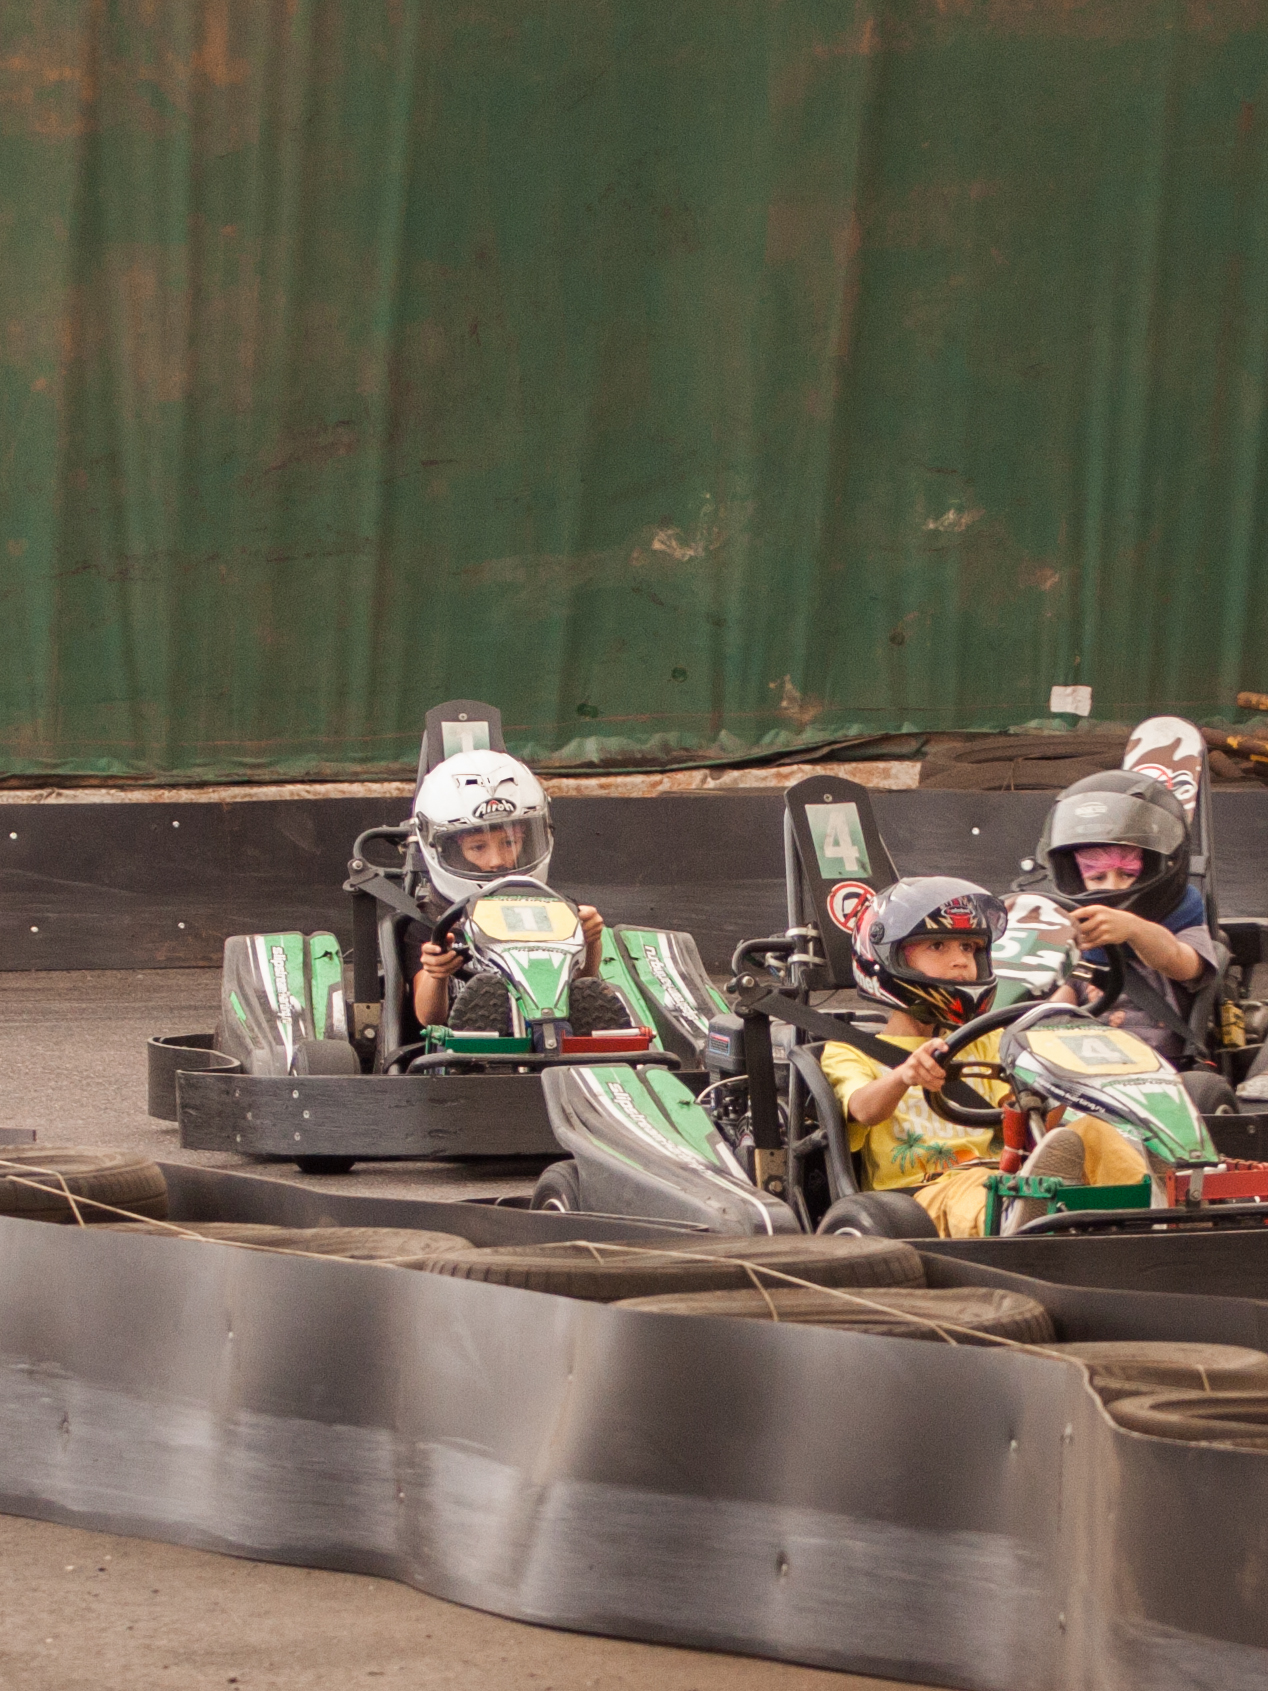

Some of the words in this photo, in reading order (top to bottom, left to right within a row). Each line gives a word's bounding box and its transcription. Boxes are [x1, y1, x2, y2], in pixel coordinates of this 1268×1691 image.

[475, 799, 516, 818] Airoh
[823, 811, 860, 872] 4
[513, 906, 540, 931] 1
[991, 930, 1028, 959] 5
[1080, 1038, 1122, 1060] 4
